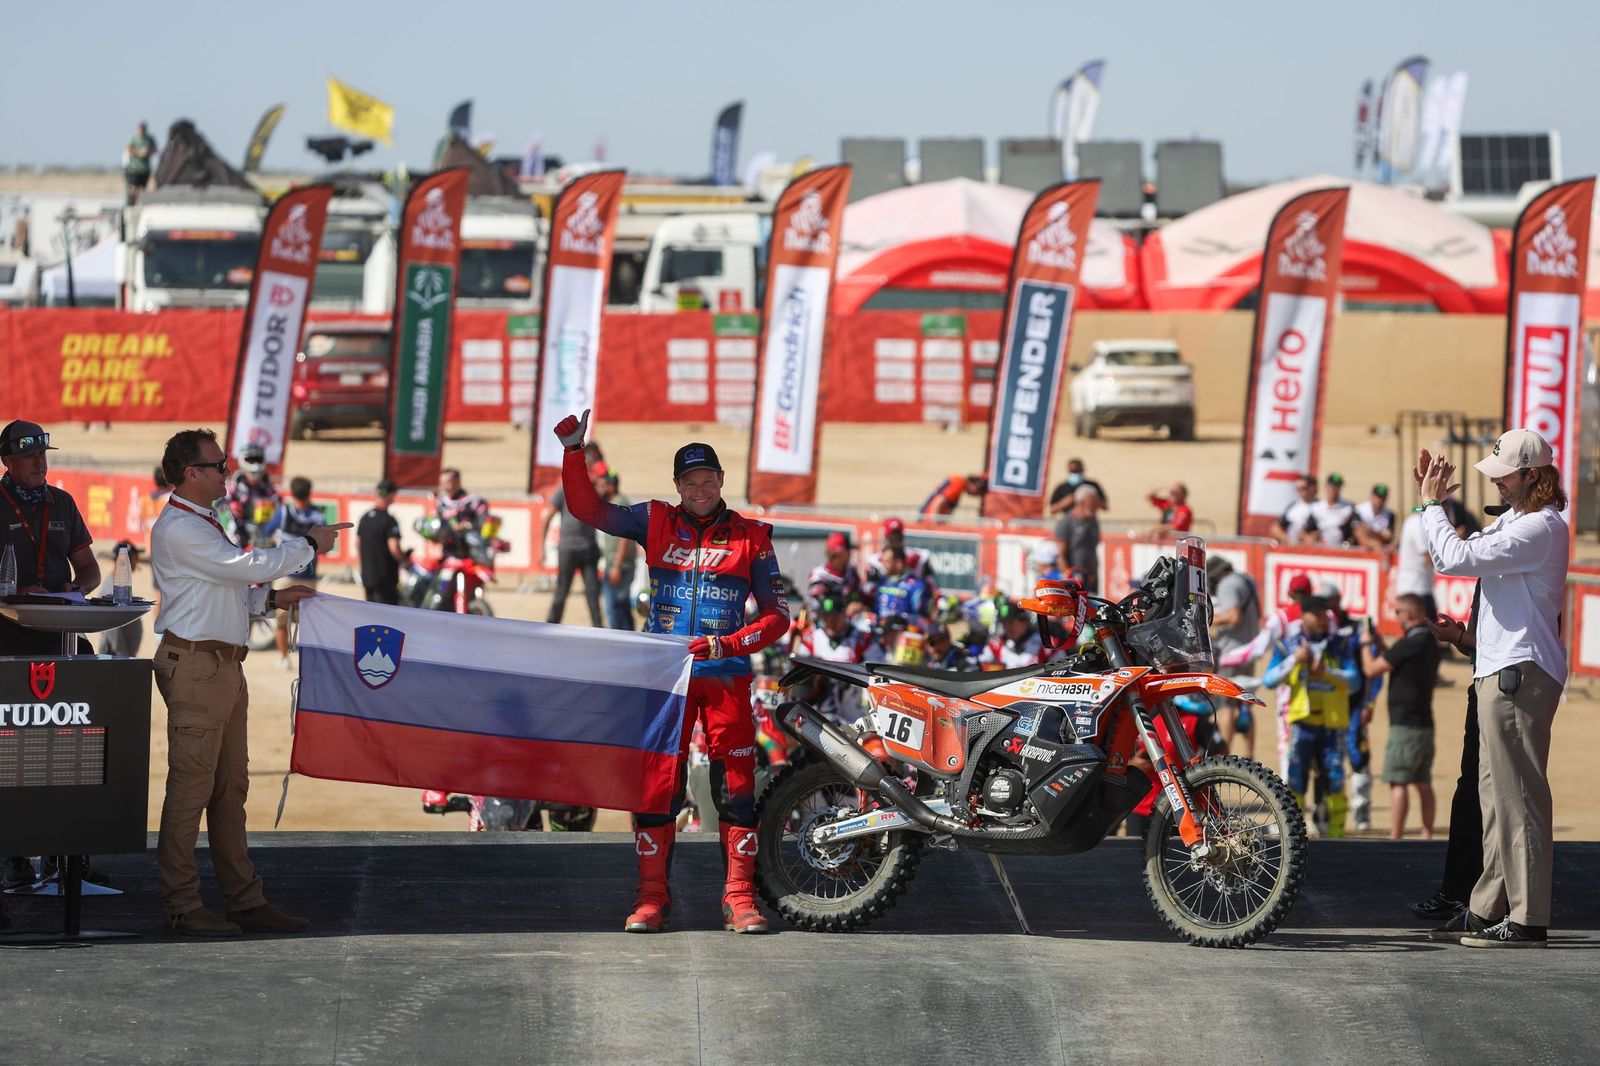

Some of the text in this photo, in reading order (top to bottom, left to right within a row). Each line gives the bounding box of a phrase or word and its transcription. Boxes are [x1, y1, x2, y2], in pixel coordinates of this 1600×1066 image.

[61, 334, 173, 358] DREAM.
[61, 359, 144, 381] DARE.
[254, 313, 289, 420] TUDOR
[409, 317, 433, 441] SAUDI ARABIA
[773, 285, 808, 453] BFGoodrich
[61, 382, 164, 407] LIVE IT.
[1003, 291, 1056, 485] DEFENDER
[1271, 329, 1307, 433] Hero
[1526, 331, 1565, 466] OTUL
[0, 702, 92, 727] TUDOR
[884, 713, 913, 743] 16
[880, 812, 896, 820] RK
